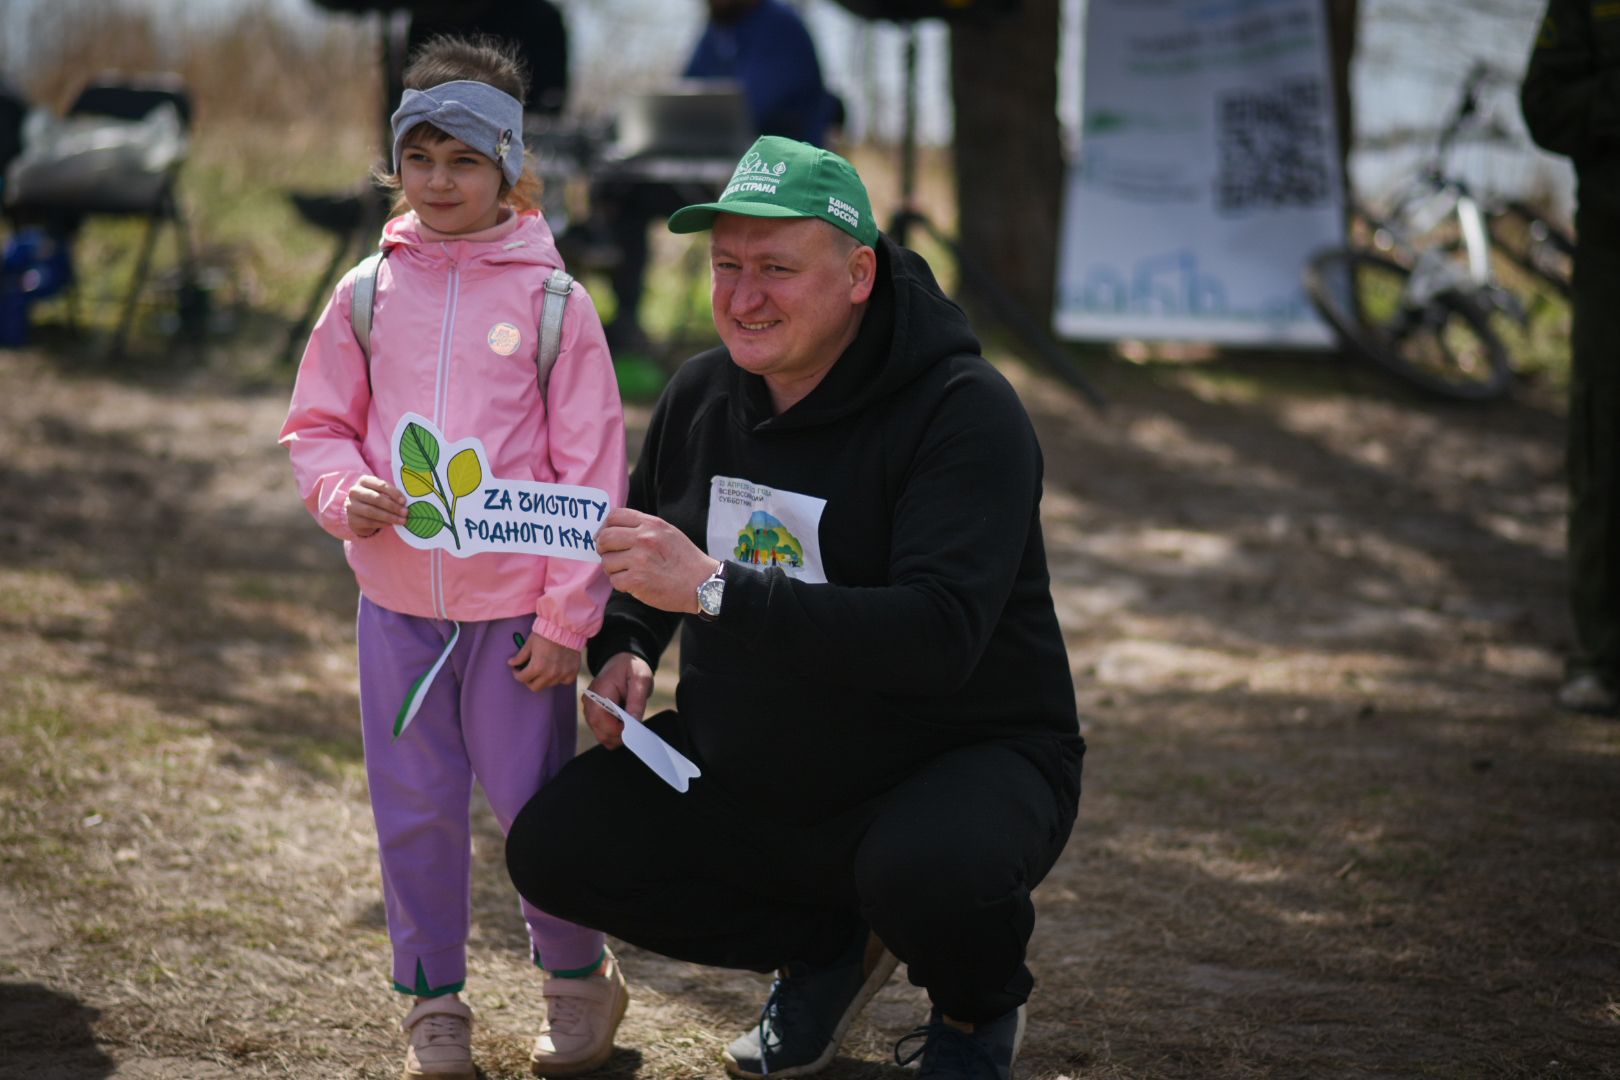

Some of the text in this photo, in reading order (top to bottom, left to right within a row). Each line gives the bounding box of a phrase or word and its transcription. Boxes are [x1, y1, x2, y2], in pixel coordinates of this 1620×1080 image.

[740, 182, 777, 195] СТРАНА
[828, 205, 858, 228] РОССИЯ
[829, 196, 859, 219] ЕДИНАЯ
[465, 518, 595, 551] РОДНОГО КРА
